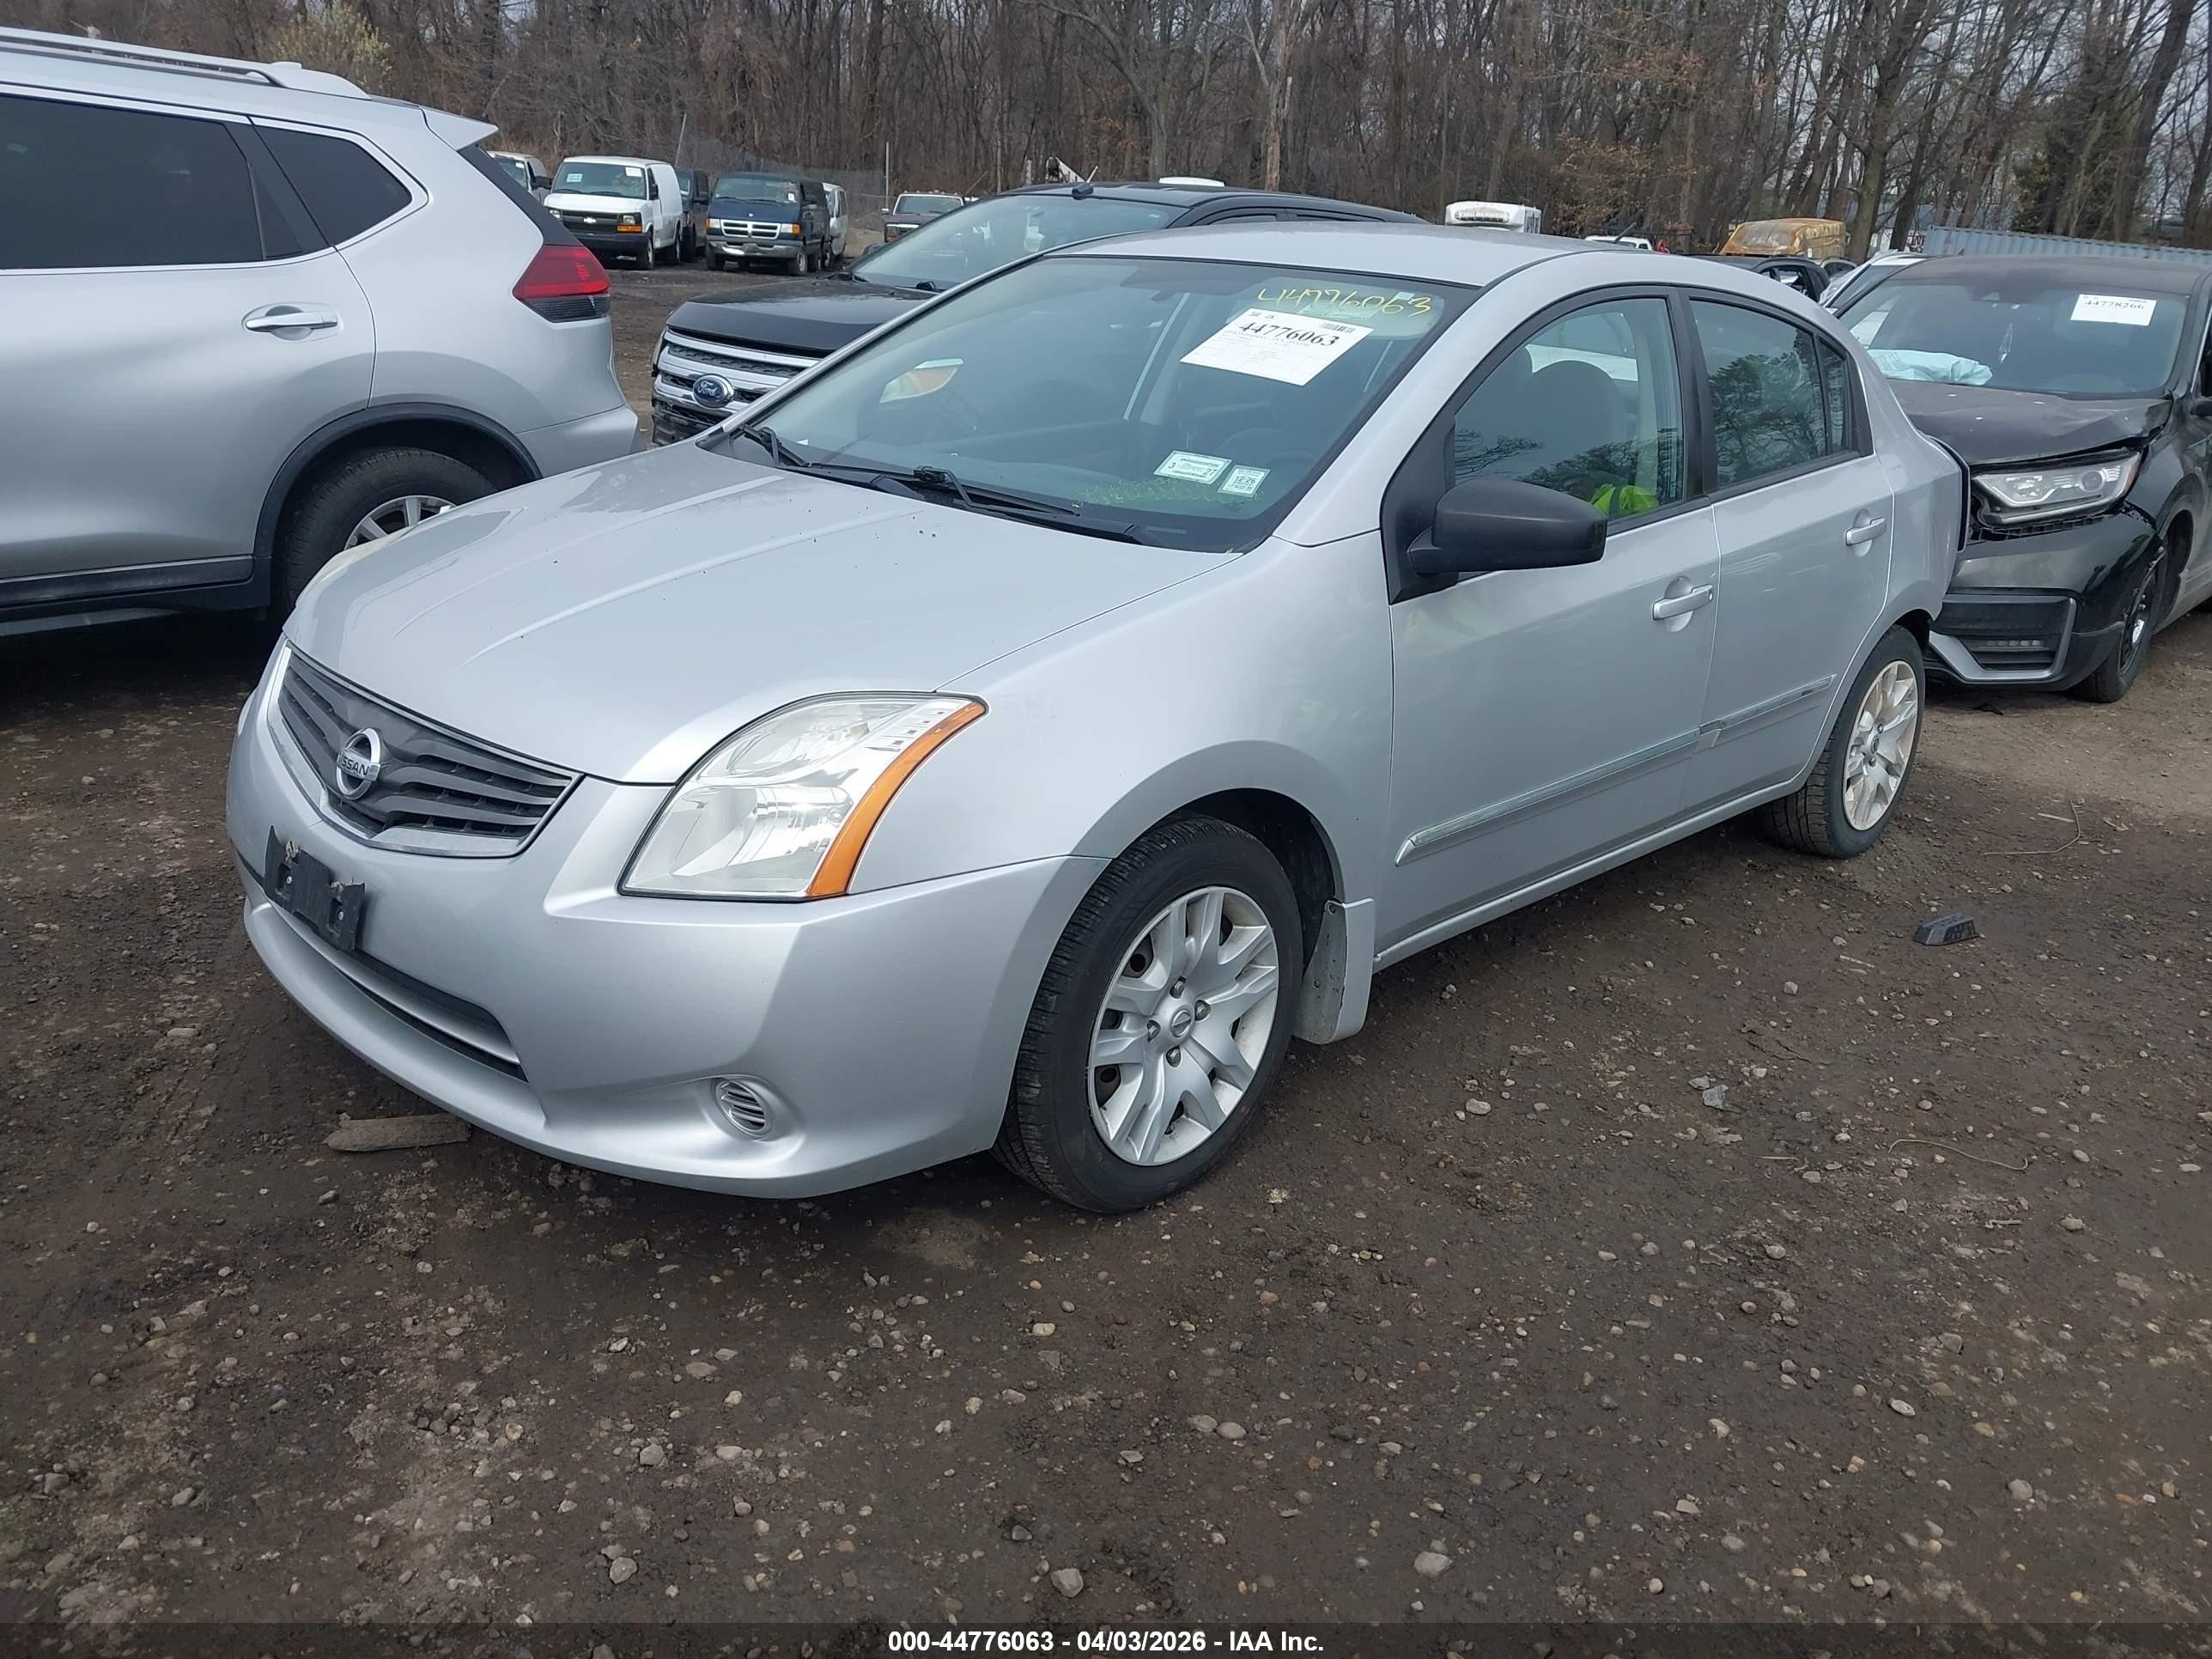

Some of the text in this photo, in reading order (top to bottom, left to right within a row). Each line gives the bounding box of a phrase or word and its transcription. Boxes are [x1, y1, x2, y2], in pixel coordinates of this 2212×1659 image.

[2084, 300, 2145, 310] 44778266
[1239, 321, 1340, 347] 44776063
[697, 380, 718, 396] Ford
[341, 754, 370, 776] SSAN
